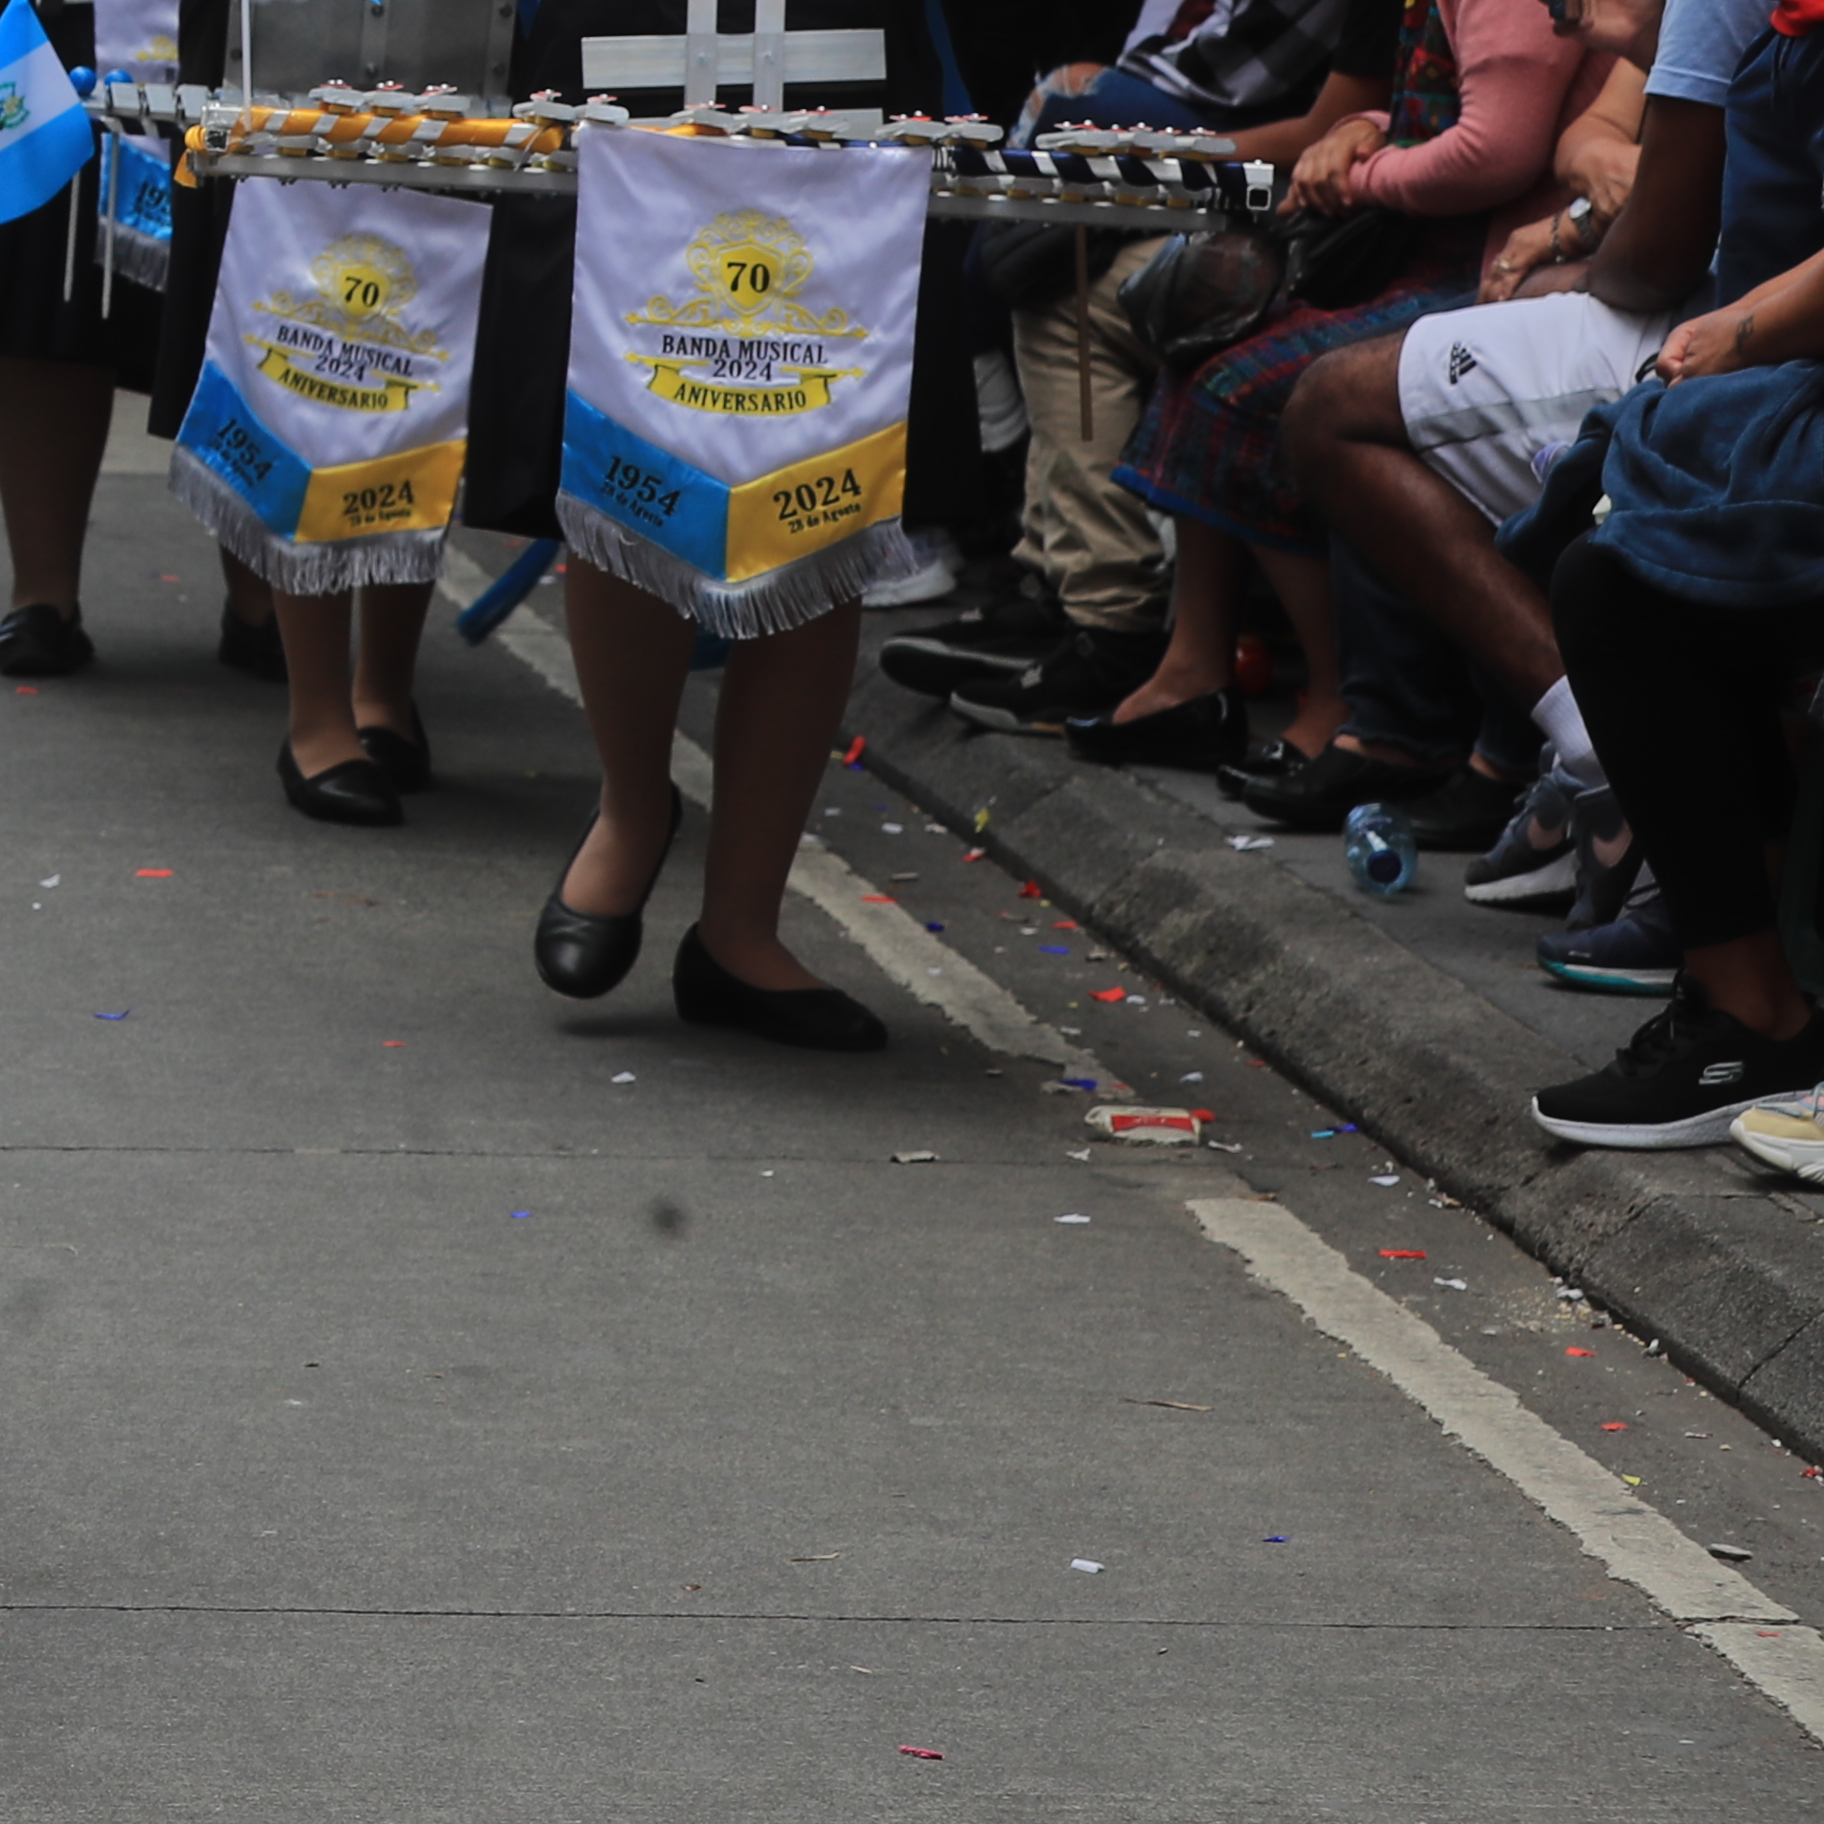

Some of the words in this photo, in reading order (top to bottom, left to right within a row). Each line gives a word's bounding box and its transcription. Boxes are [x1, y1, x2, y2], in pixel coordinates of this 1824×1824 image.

[344, 275, 380, 308] 70
[726, 261, 772, 294] 70
[277, 324, 335, 357] BANDA
[339, 342, 413, 378] MUSICAL
[661, 334, 732, 360] BANDA
[738, 339, 830, 365] MUSICAL
[314, 356, 367, 383] 2024
[712, 358, 773, 383] 2024
[277, 367, 389, 410] ANIVERSARIO
[673, 382, 808, 413] ANIVERSARIO
[216, 417, 273, 481] 1954
[342, 478, 416, 516] 2024
[604, 455, 683, 518] 1954
[772, 467, 863, 522] 2024
